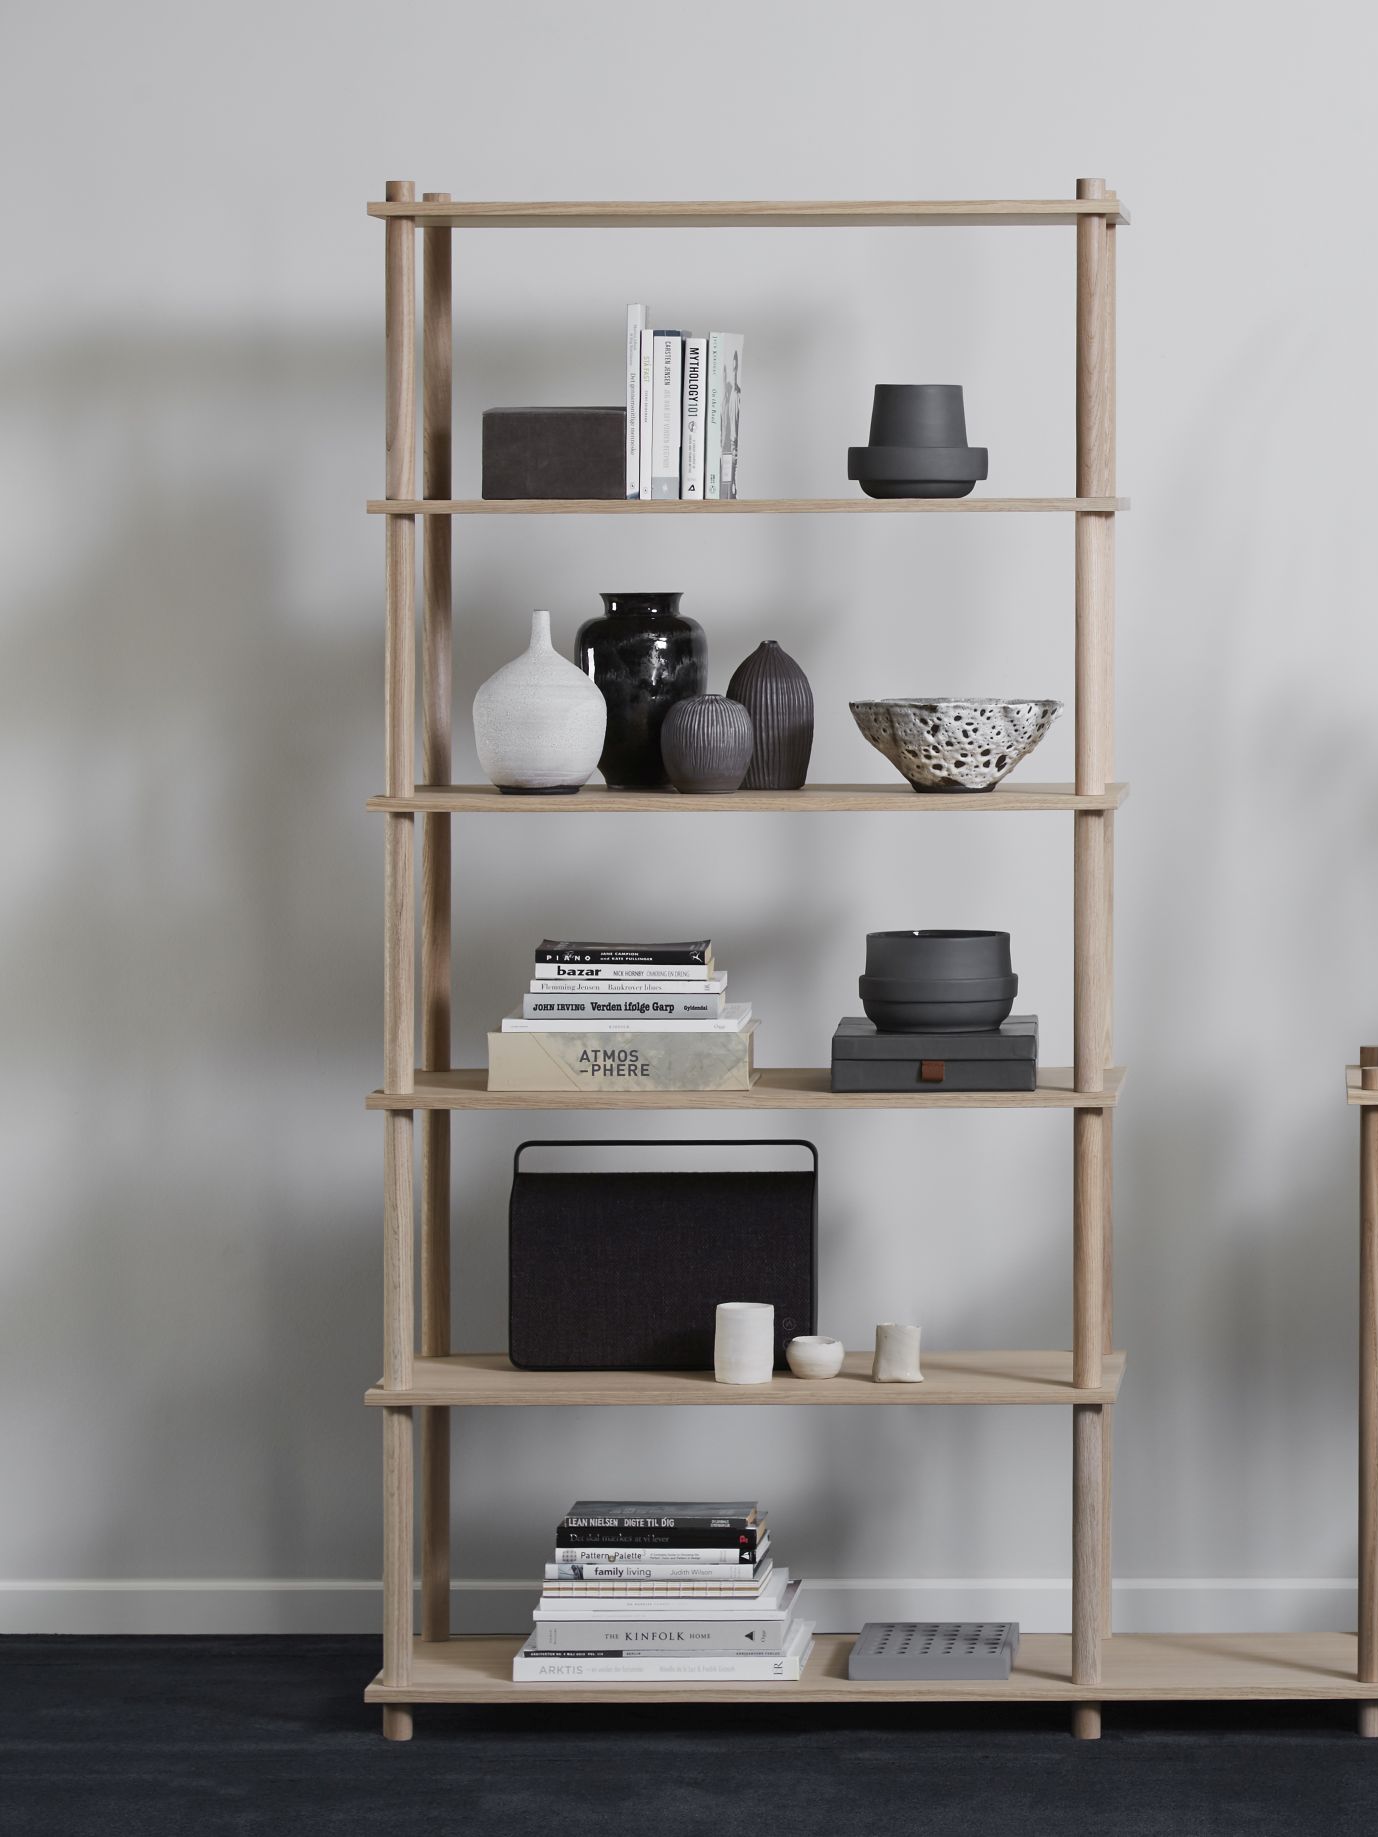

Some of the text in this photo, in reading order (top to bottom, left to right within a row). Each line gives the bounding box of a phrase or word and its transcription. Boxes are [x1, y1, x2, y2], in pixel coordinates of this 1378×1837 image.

[664, 341, 672, 365] CARSTEN
[557, 965, 602, 976] bazar
[541, 983, 600, 991] Flemming Jensen
[532, 1003, 586, 1012] JOHN IRVING
[590, 1001, 675, 1014] Verden ifølge Garp
[579, 1049, 639, 1063] ATMOS
[568, 1518, 618, 1527] LEAN NIELSEN
[624, 1518, 645, 1527] DIGTE
[646, 1518, 660, 1527] TIL
[569, 1533, 584, 1542] Det
[580, 1551, 609, 1560] Pattern
[614, 1551, 642, 1560] Palette
[594, 1566, 652, 1578] family living
[670, 1568, 713, 1577] Judith Wilson
[625, 1631, 685, 1641] KINFOLK
[539, 1665, 584, 1675] ARKTIS
